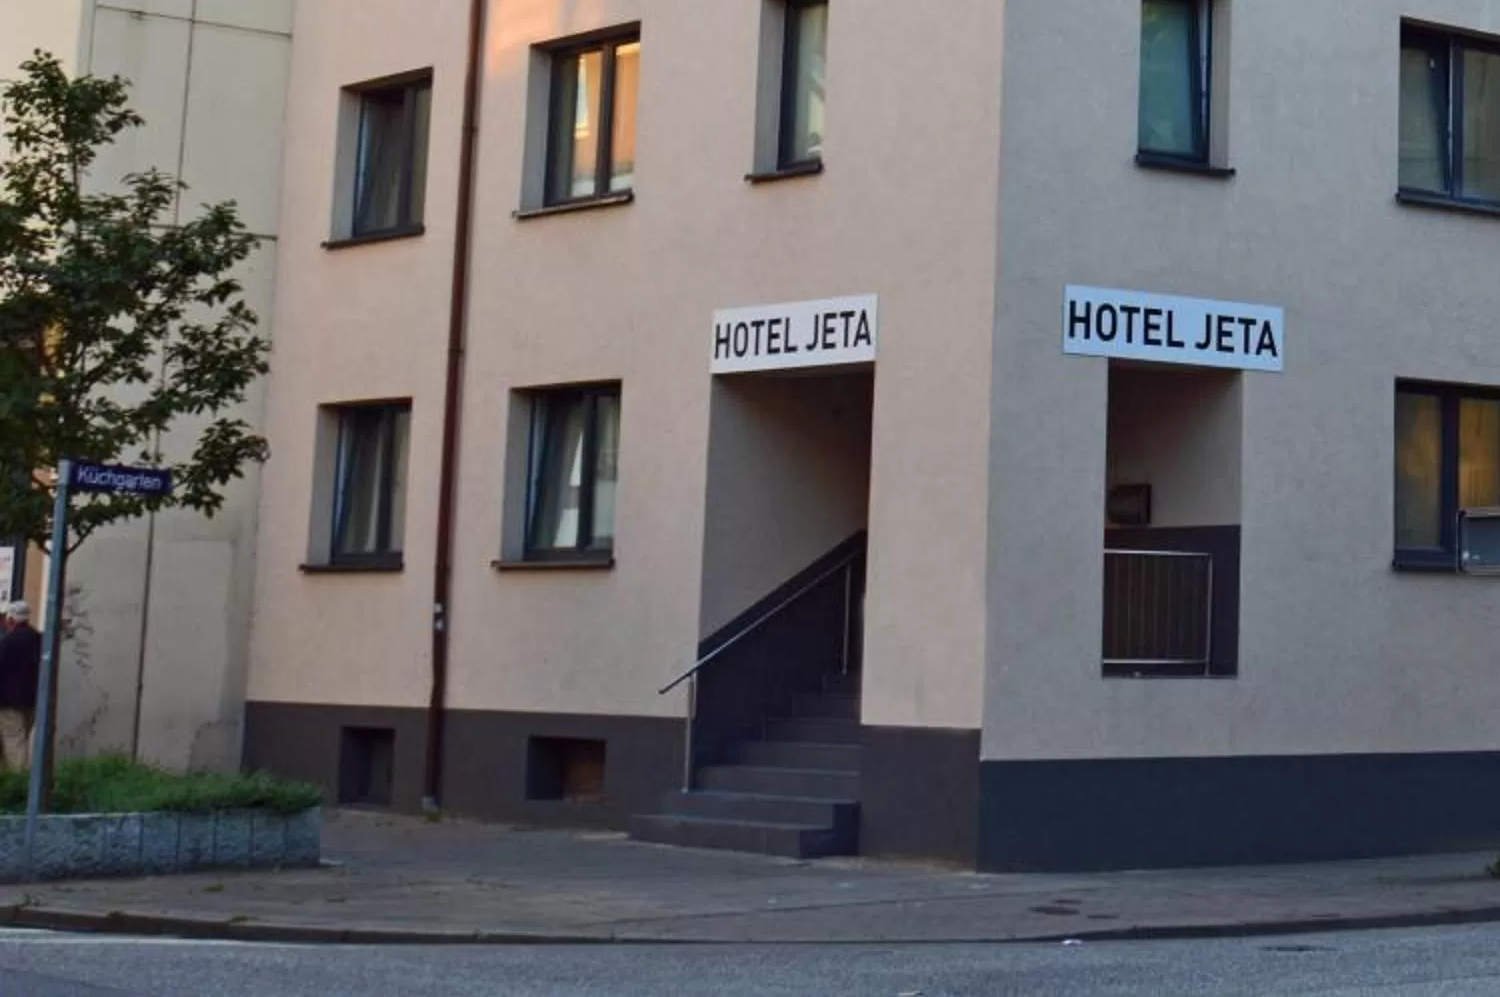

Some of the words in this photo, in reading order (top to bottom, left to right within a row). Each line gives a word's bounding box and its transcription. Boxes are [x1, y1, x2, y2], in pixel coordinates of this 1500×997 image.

[714, 316, 798, 359] HOTEL
[805, 308, 872, 351] JETA
[1068, 299, 1185, 348] HOTEL
[1195, 313, 1279, 357] JETA
